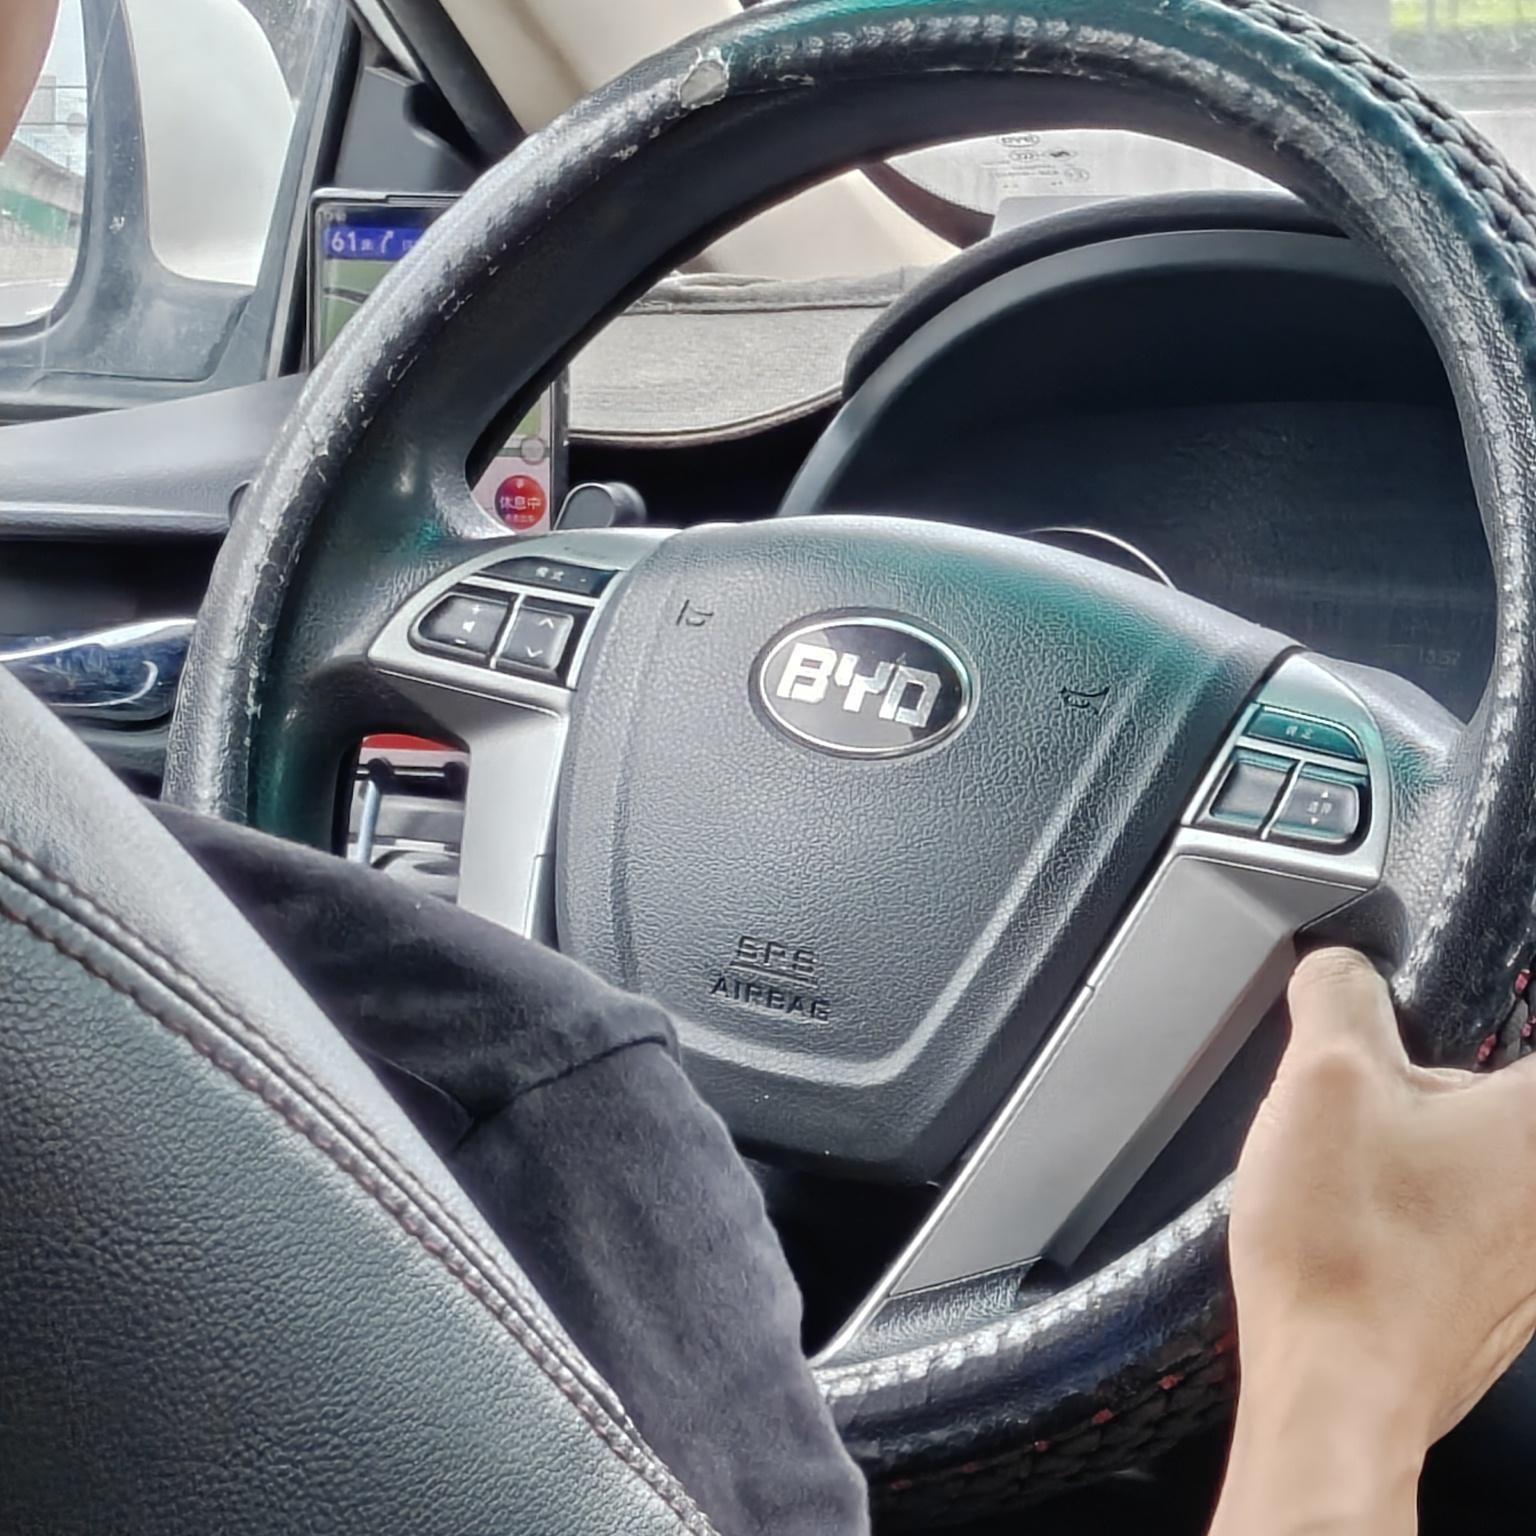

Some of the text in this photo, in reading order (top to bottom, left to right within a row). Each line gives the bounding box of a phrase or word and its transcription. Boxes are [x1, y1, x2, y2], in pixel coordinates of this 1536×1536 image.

[501, 495, 541, 511] 休息中
[776, 642, 942, 728] BYD
[709, 976, 831, 1022] AIRBAG
